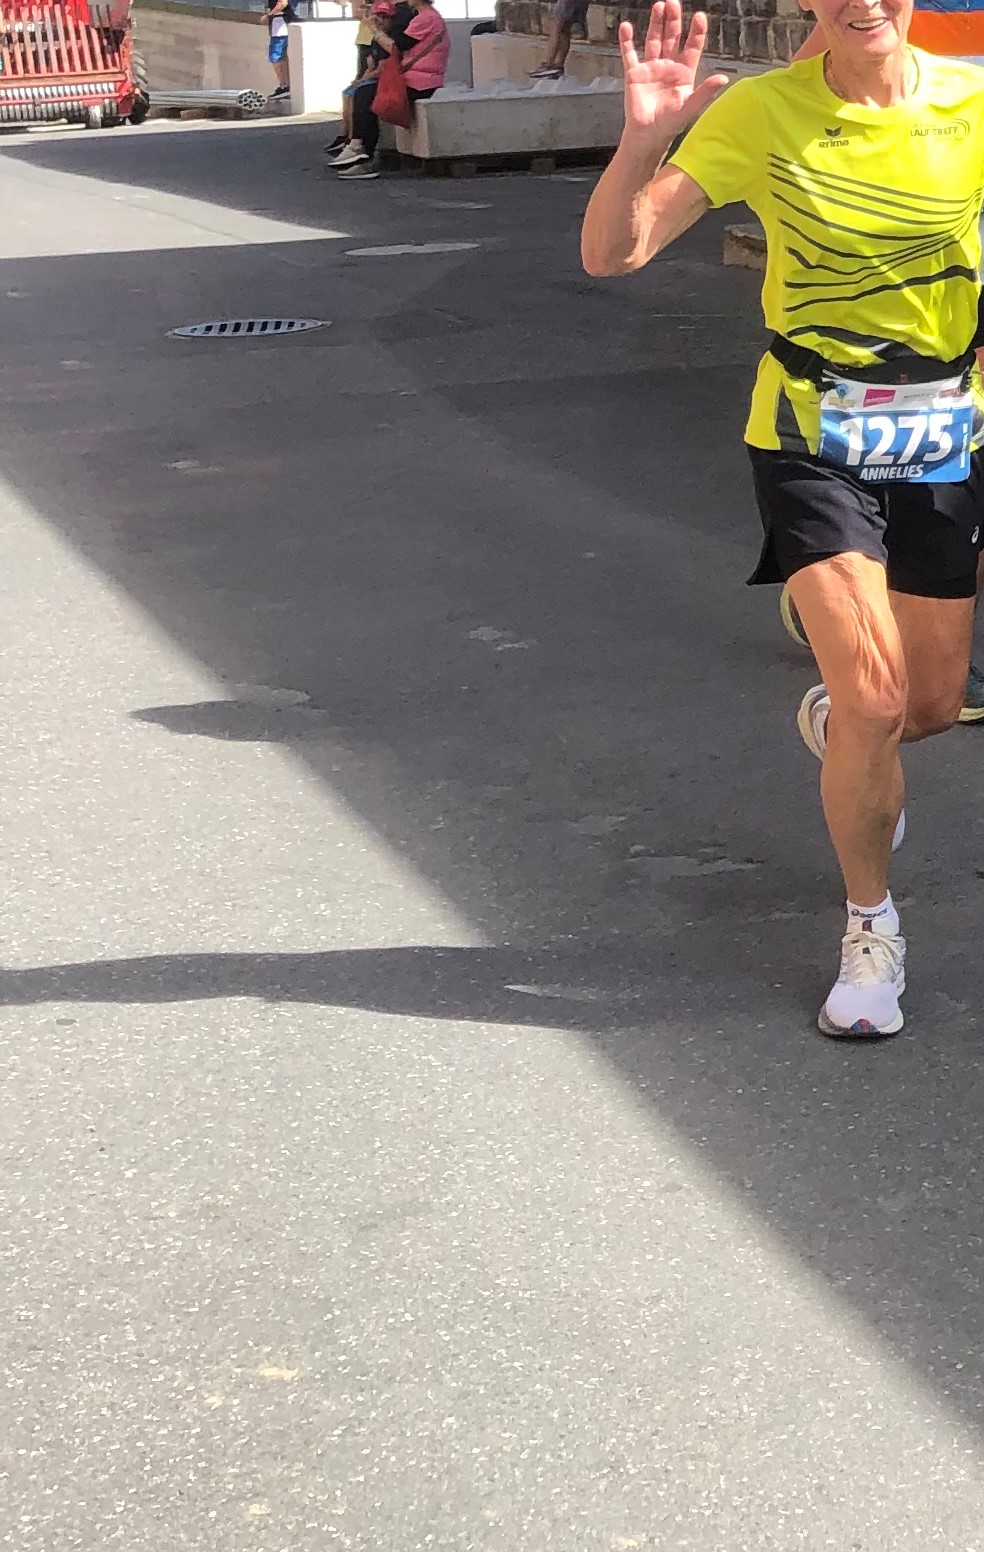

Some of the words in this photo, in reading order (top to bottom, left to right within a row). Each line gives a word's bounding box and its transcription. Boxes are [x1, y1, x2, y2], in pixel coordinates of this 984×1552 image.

[818, 138, 850, 148] erima
[838, 412, 954, 466] 1275
[858, 463, 925, 481] ANNELIES
